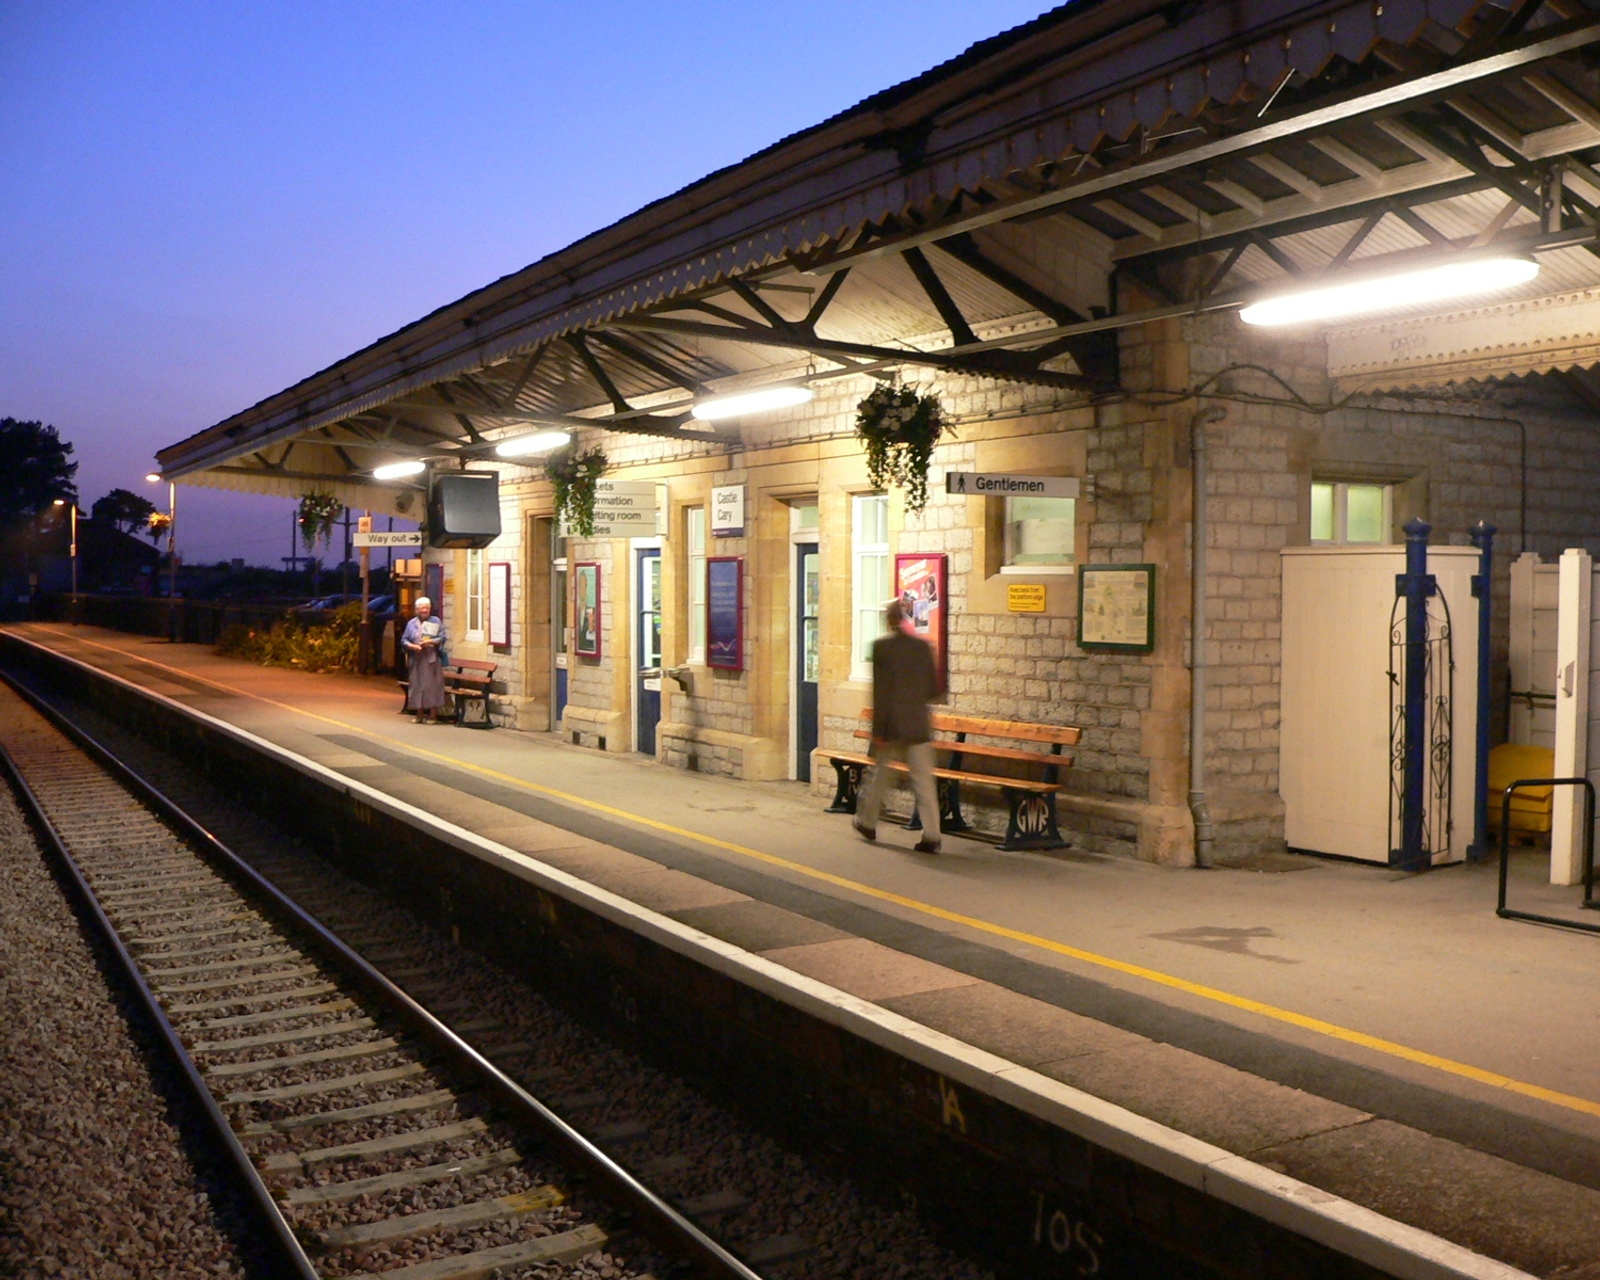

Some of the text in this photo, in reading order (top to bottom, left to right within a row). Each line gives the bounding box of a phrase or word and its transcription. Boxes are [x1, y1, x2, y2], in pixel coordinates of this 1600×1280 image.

[976, 476, 1045, 492] Gentlemen
[717, 492, 738, 504] Castle
[593, 510, 642, 521] iting room
[717, 509, 732, 522] Cary
[368, 534, 407, 544] Way out
[1017, 798, 1049, 832] GWR
